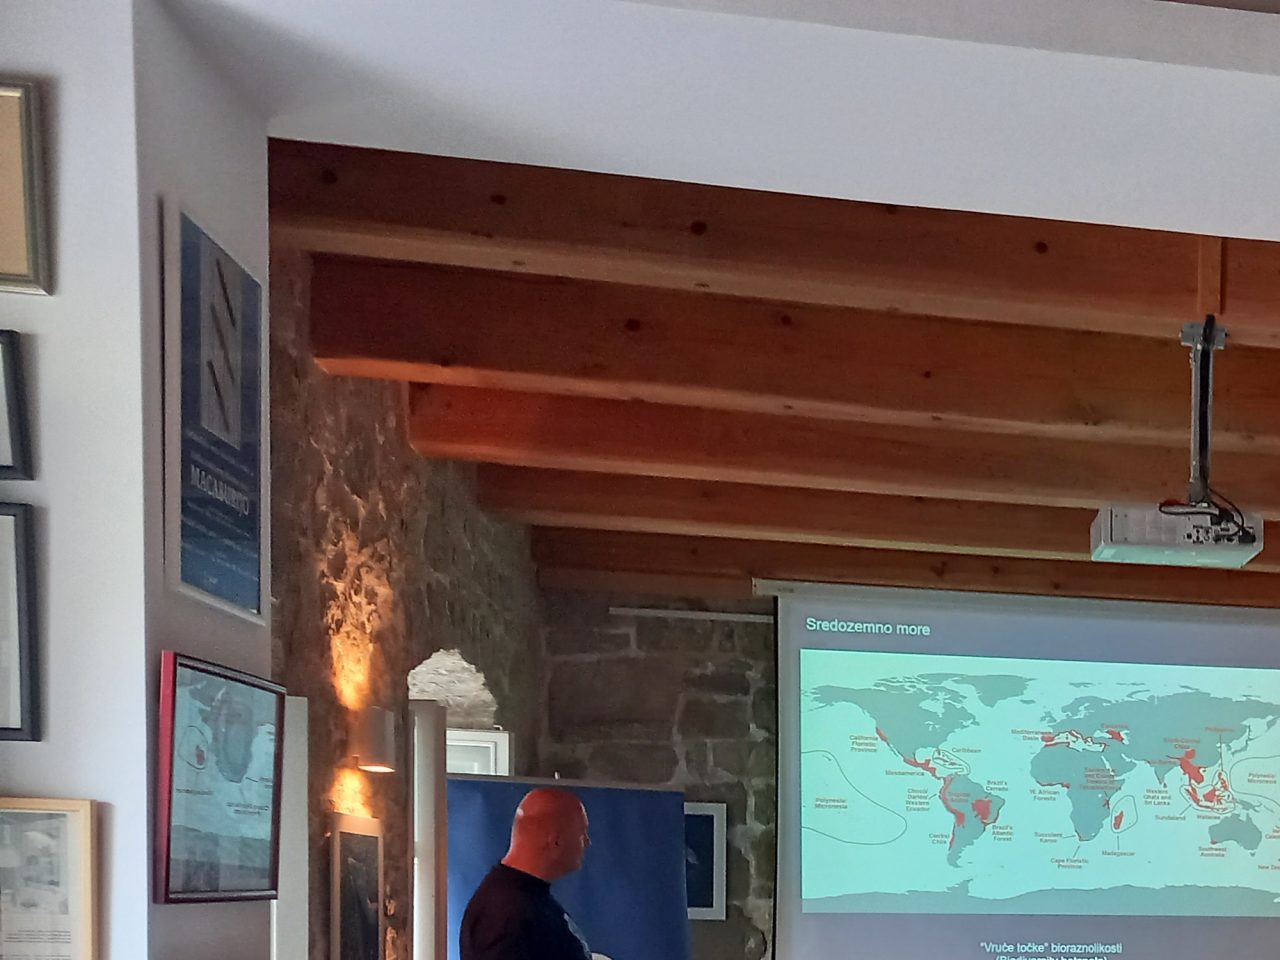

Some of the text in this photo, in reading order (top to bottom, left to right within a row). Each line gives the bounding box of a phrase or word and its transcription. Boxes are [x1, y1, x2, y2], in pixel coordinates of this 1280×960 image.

[806, 617, 931, 636] Sredozemno more
[1051, 942, 1122, 954] bioraznolikosti
